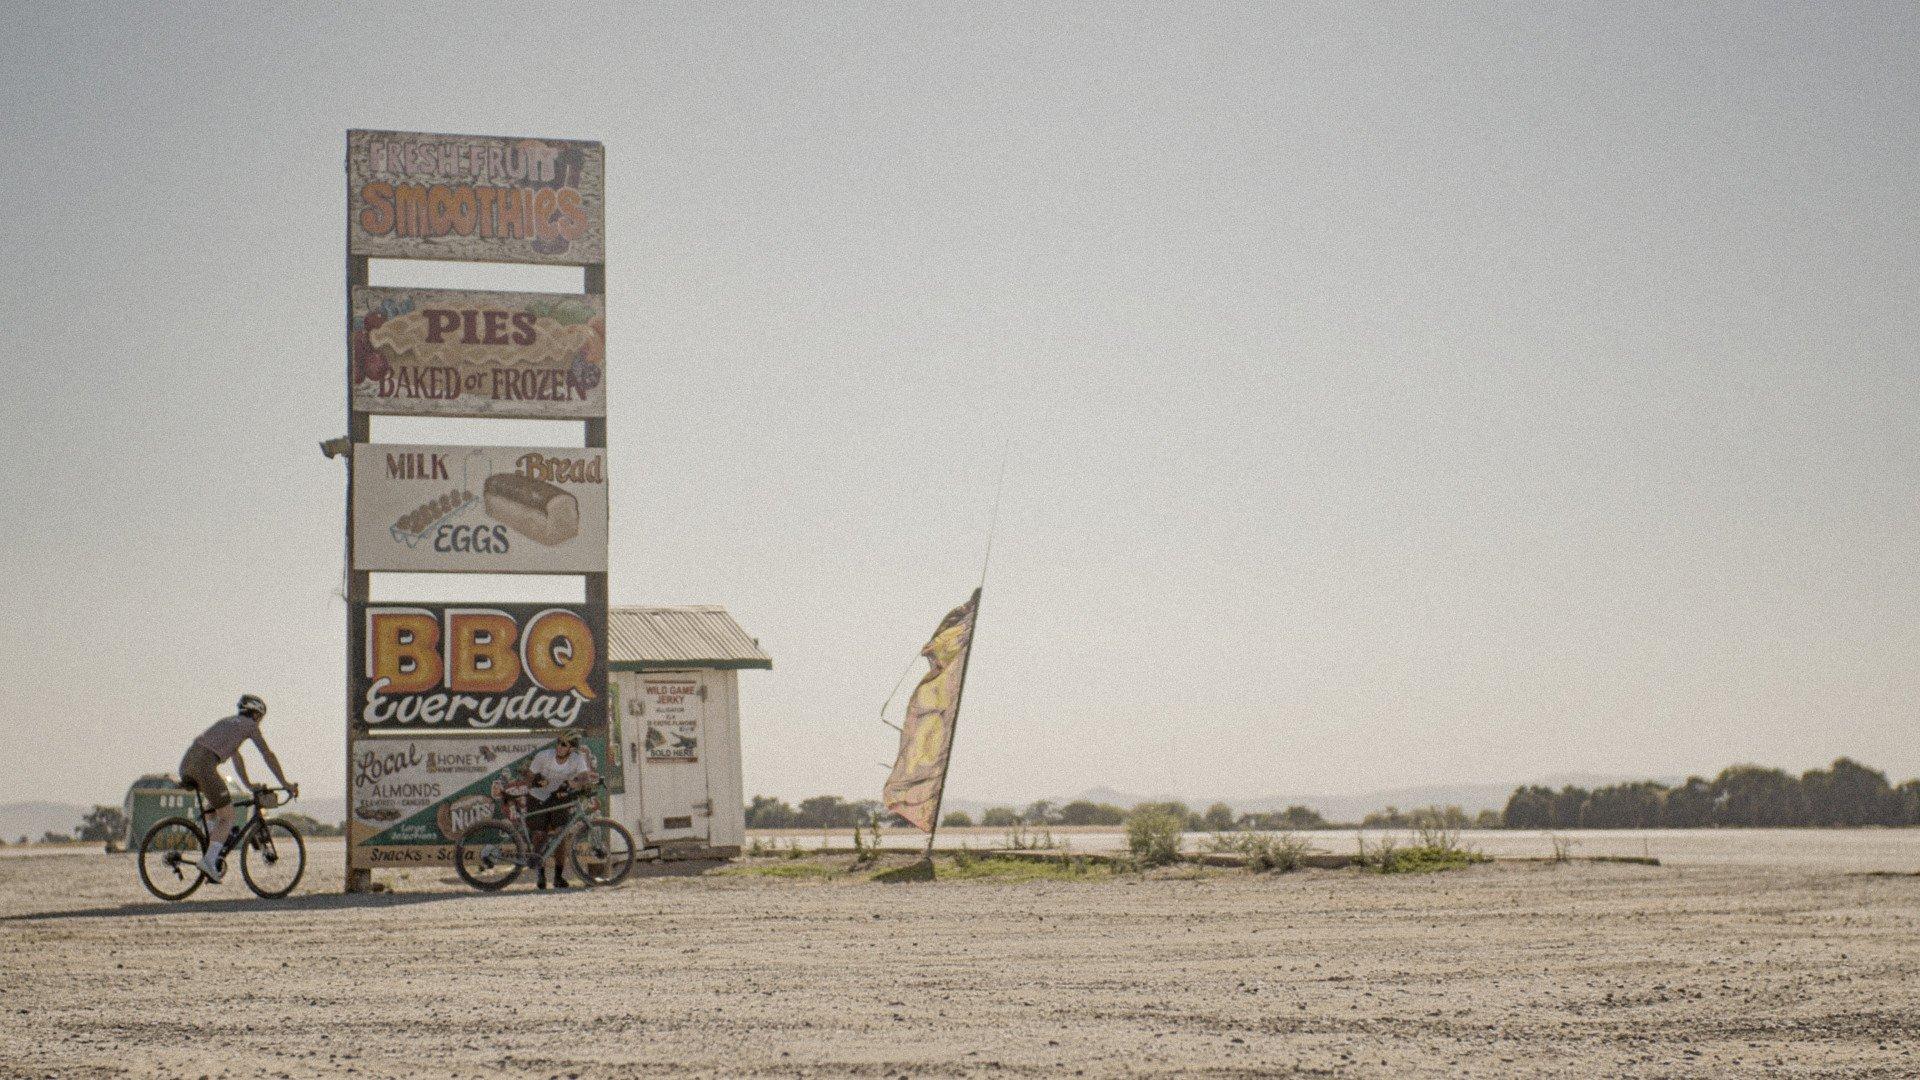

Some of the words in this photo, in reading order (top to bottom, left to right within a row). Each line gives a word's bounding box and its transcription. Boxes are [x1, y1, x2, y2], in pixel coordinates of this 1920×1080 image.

[370, 142, 460, 176] FRESH
[422, 309, 538, 346] PIES
[377, 365, 461, 400] BAKED
[464, 371, 487, 391] or
[491, 366, 588, 401] FROZEN
[386, 452, 449, 480] MILK
[515, 452, 604, 484] Bread
[434, 524, 510, 554] EGGS
[365, 607, 597, 701] BBQ
[363, 677, 589, 727] Everyday
[646, 686, 667, 695] WILD
[670, 686, 695, 695] GAME
[657, 695, 685, 704] JERKY
[356, 743, 422, 788] Local
[437, 754, 481, 765] HONEY
[650, 749, 671, 757] SOLD
[673, 748, 695, 757] HERE
[372, 783, 441, 797] ALMONDS
[371, 848, 422, 861] Snacks
[437, 848, 474, 861] Soa
